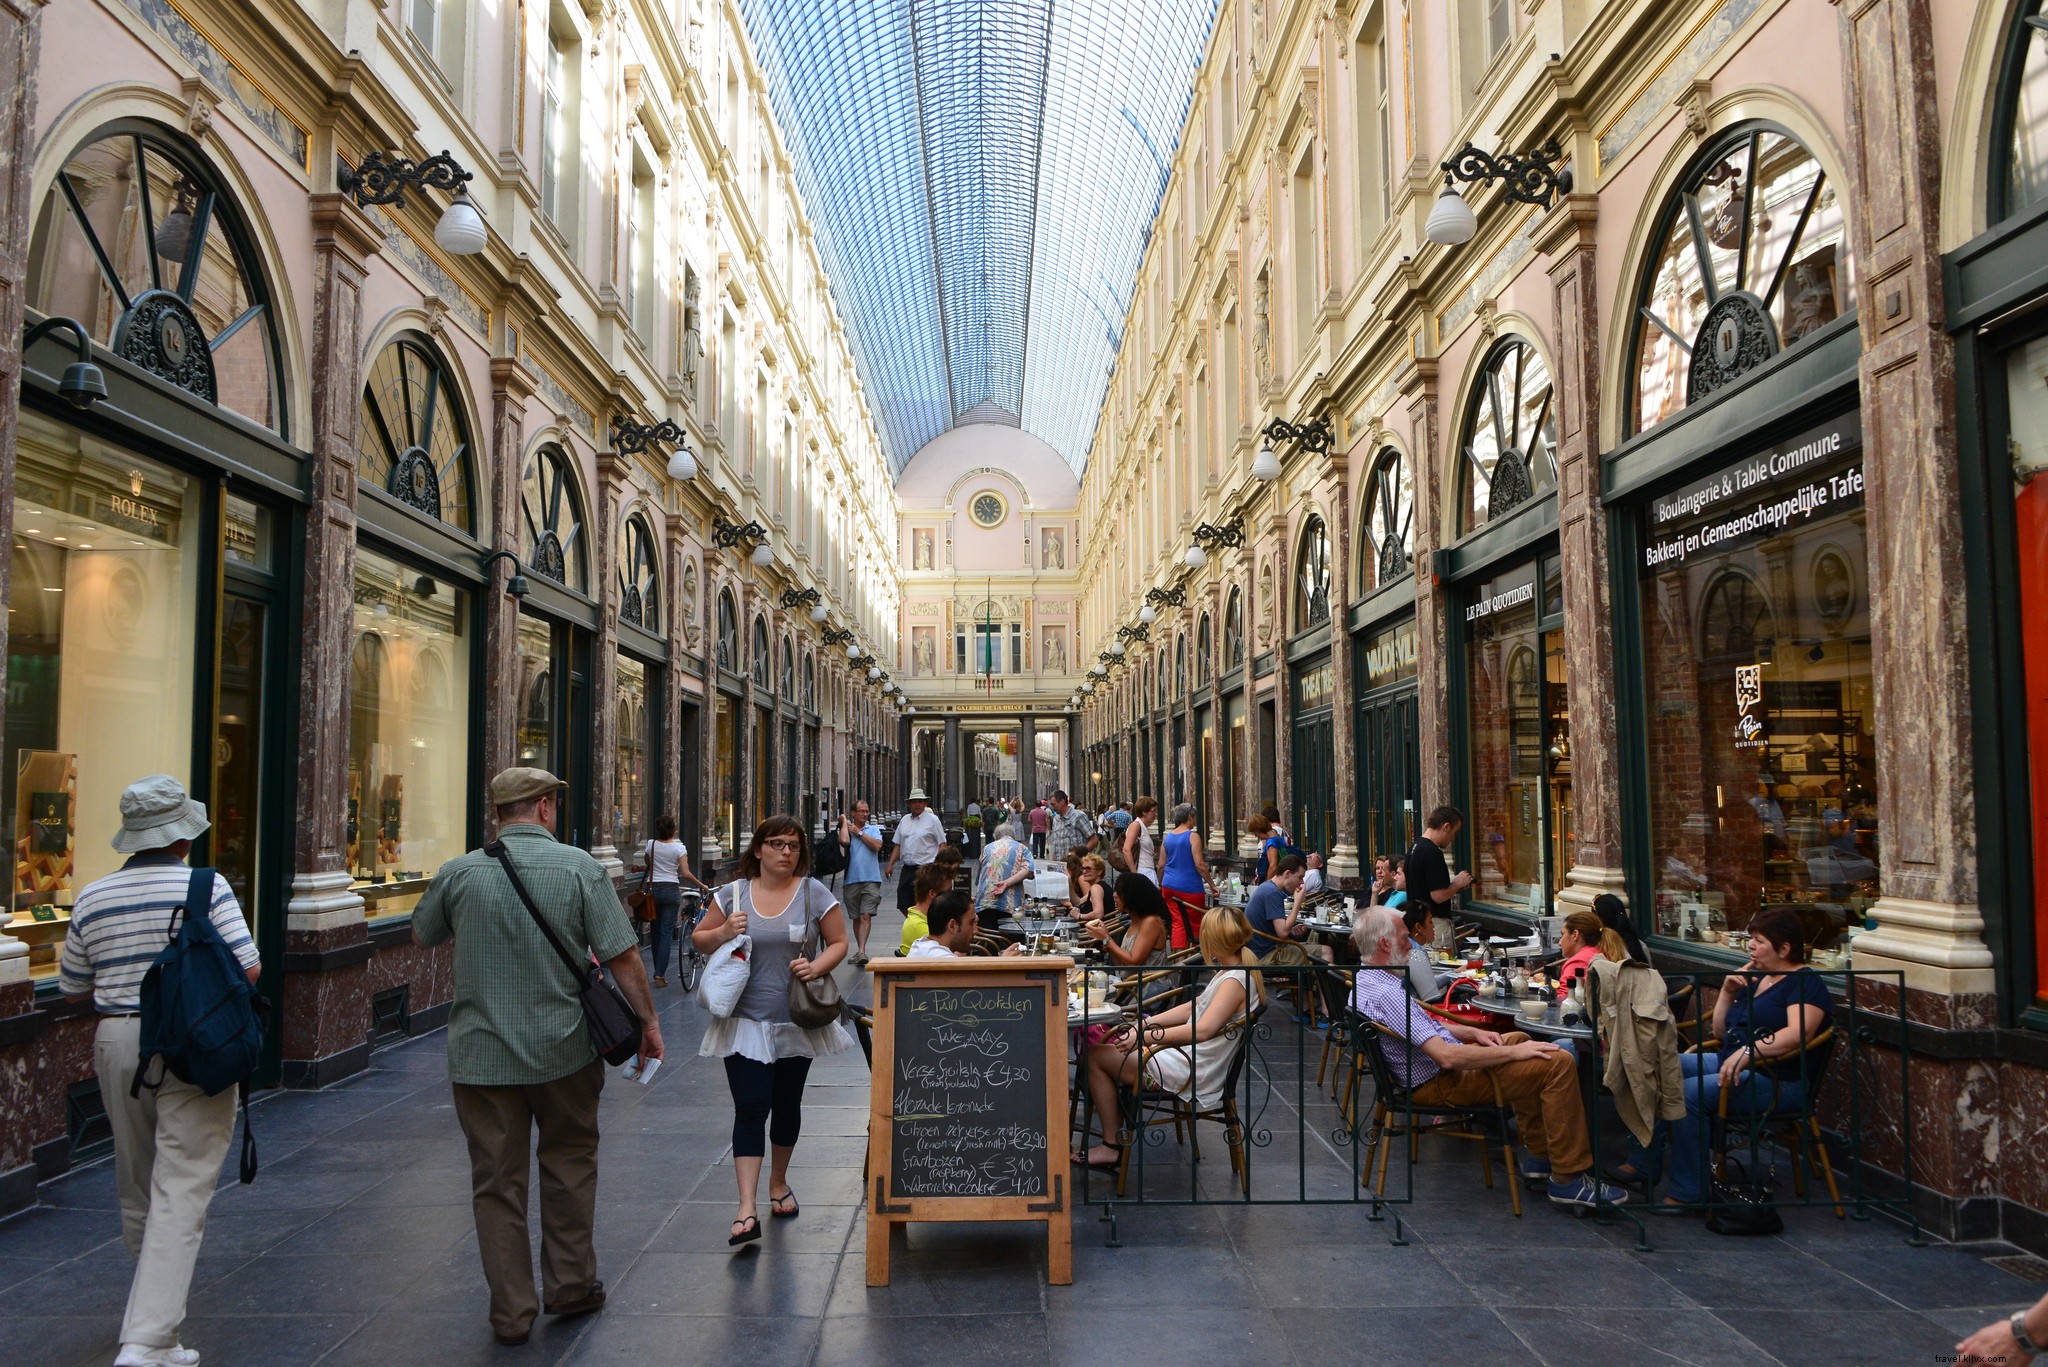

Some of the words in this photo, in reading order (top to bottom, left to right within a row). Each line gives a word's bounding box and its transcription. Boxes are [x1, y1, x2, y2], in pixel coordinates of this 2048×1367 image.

[1659, 481, 1720, 523] Boulangerie
[1721, 474, 1733, 497] &
[1734, 460, 1768, 491] Table
[1769, 432, 1840, 476] Commune
[111, 494, 159, 527] ROLEX
[1646, 534, 1684, 566] Bakkerij
[1685, 534, 1700, 553] en
[1701, 483, 1828, 547] Gemeenschappelijke
[1466, 605, 1475, 621] LE
[1475, 598, 1492, 618] PAIN
[1492, 582, 1533, 612] QUOTIDIEN
[1366, 630, 1419, 679] VAUDEVILL
[1301, 667, 1335, 702] THEATRE
[1735, 739, 1769, 749] QUOTIDIEN
[1738, 715, 1762, 739] Pain
[961, 989, 1032, 1011] Quotidien
